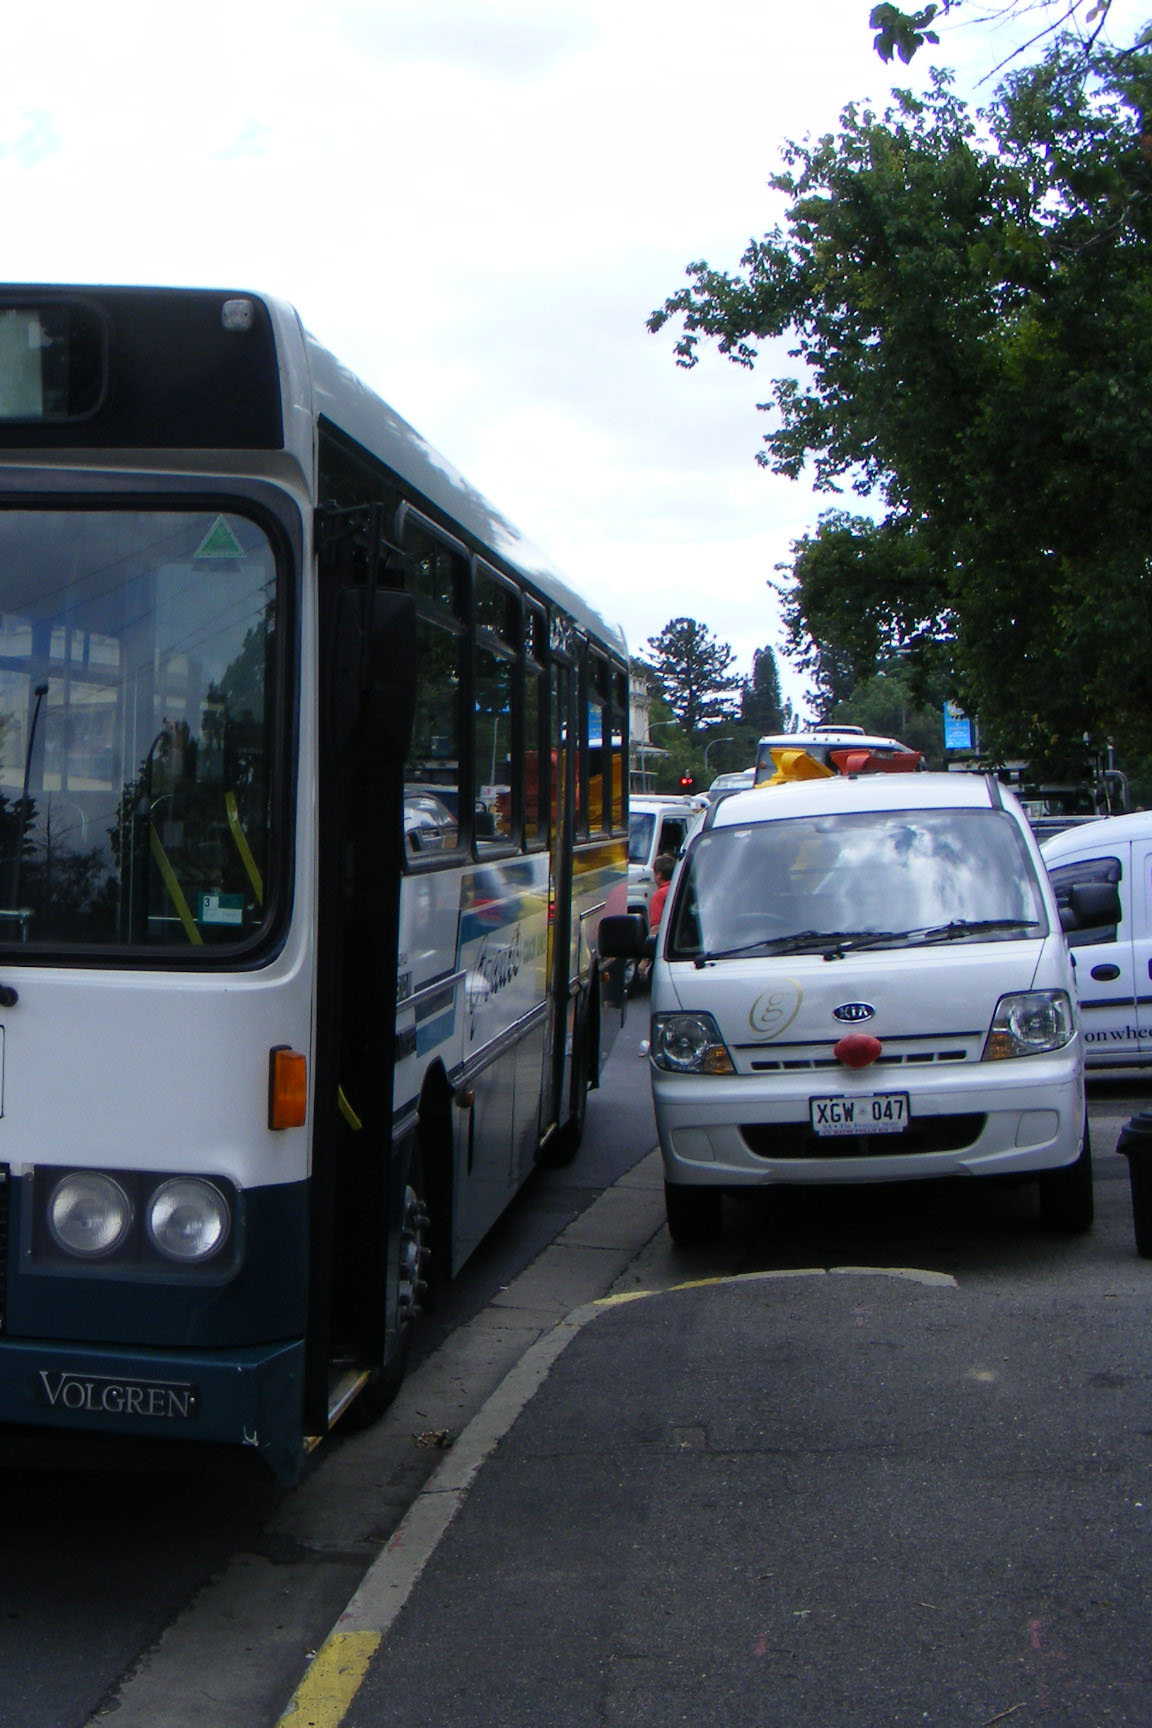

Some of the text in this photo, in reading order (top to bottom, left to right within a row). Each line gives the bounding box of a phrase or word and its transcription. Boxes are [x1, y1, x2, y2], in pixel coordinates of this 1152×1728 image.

[839, 1005, 870, 1019] KIA
[1084, 1031, 1108, 1042] on
[817, 1100, 903, 1124] XGW 047
